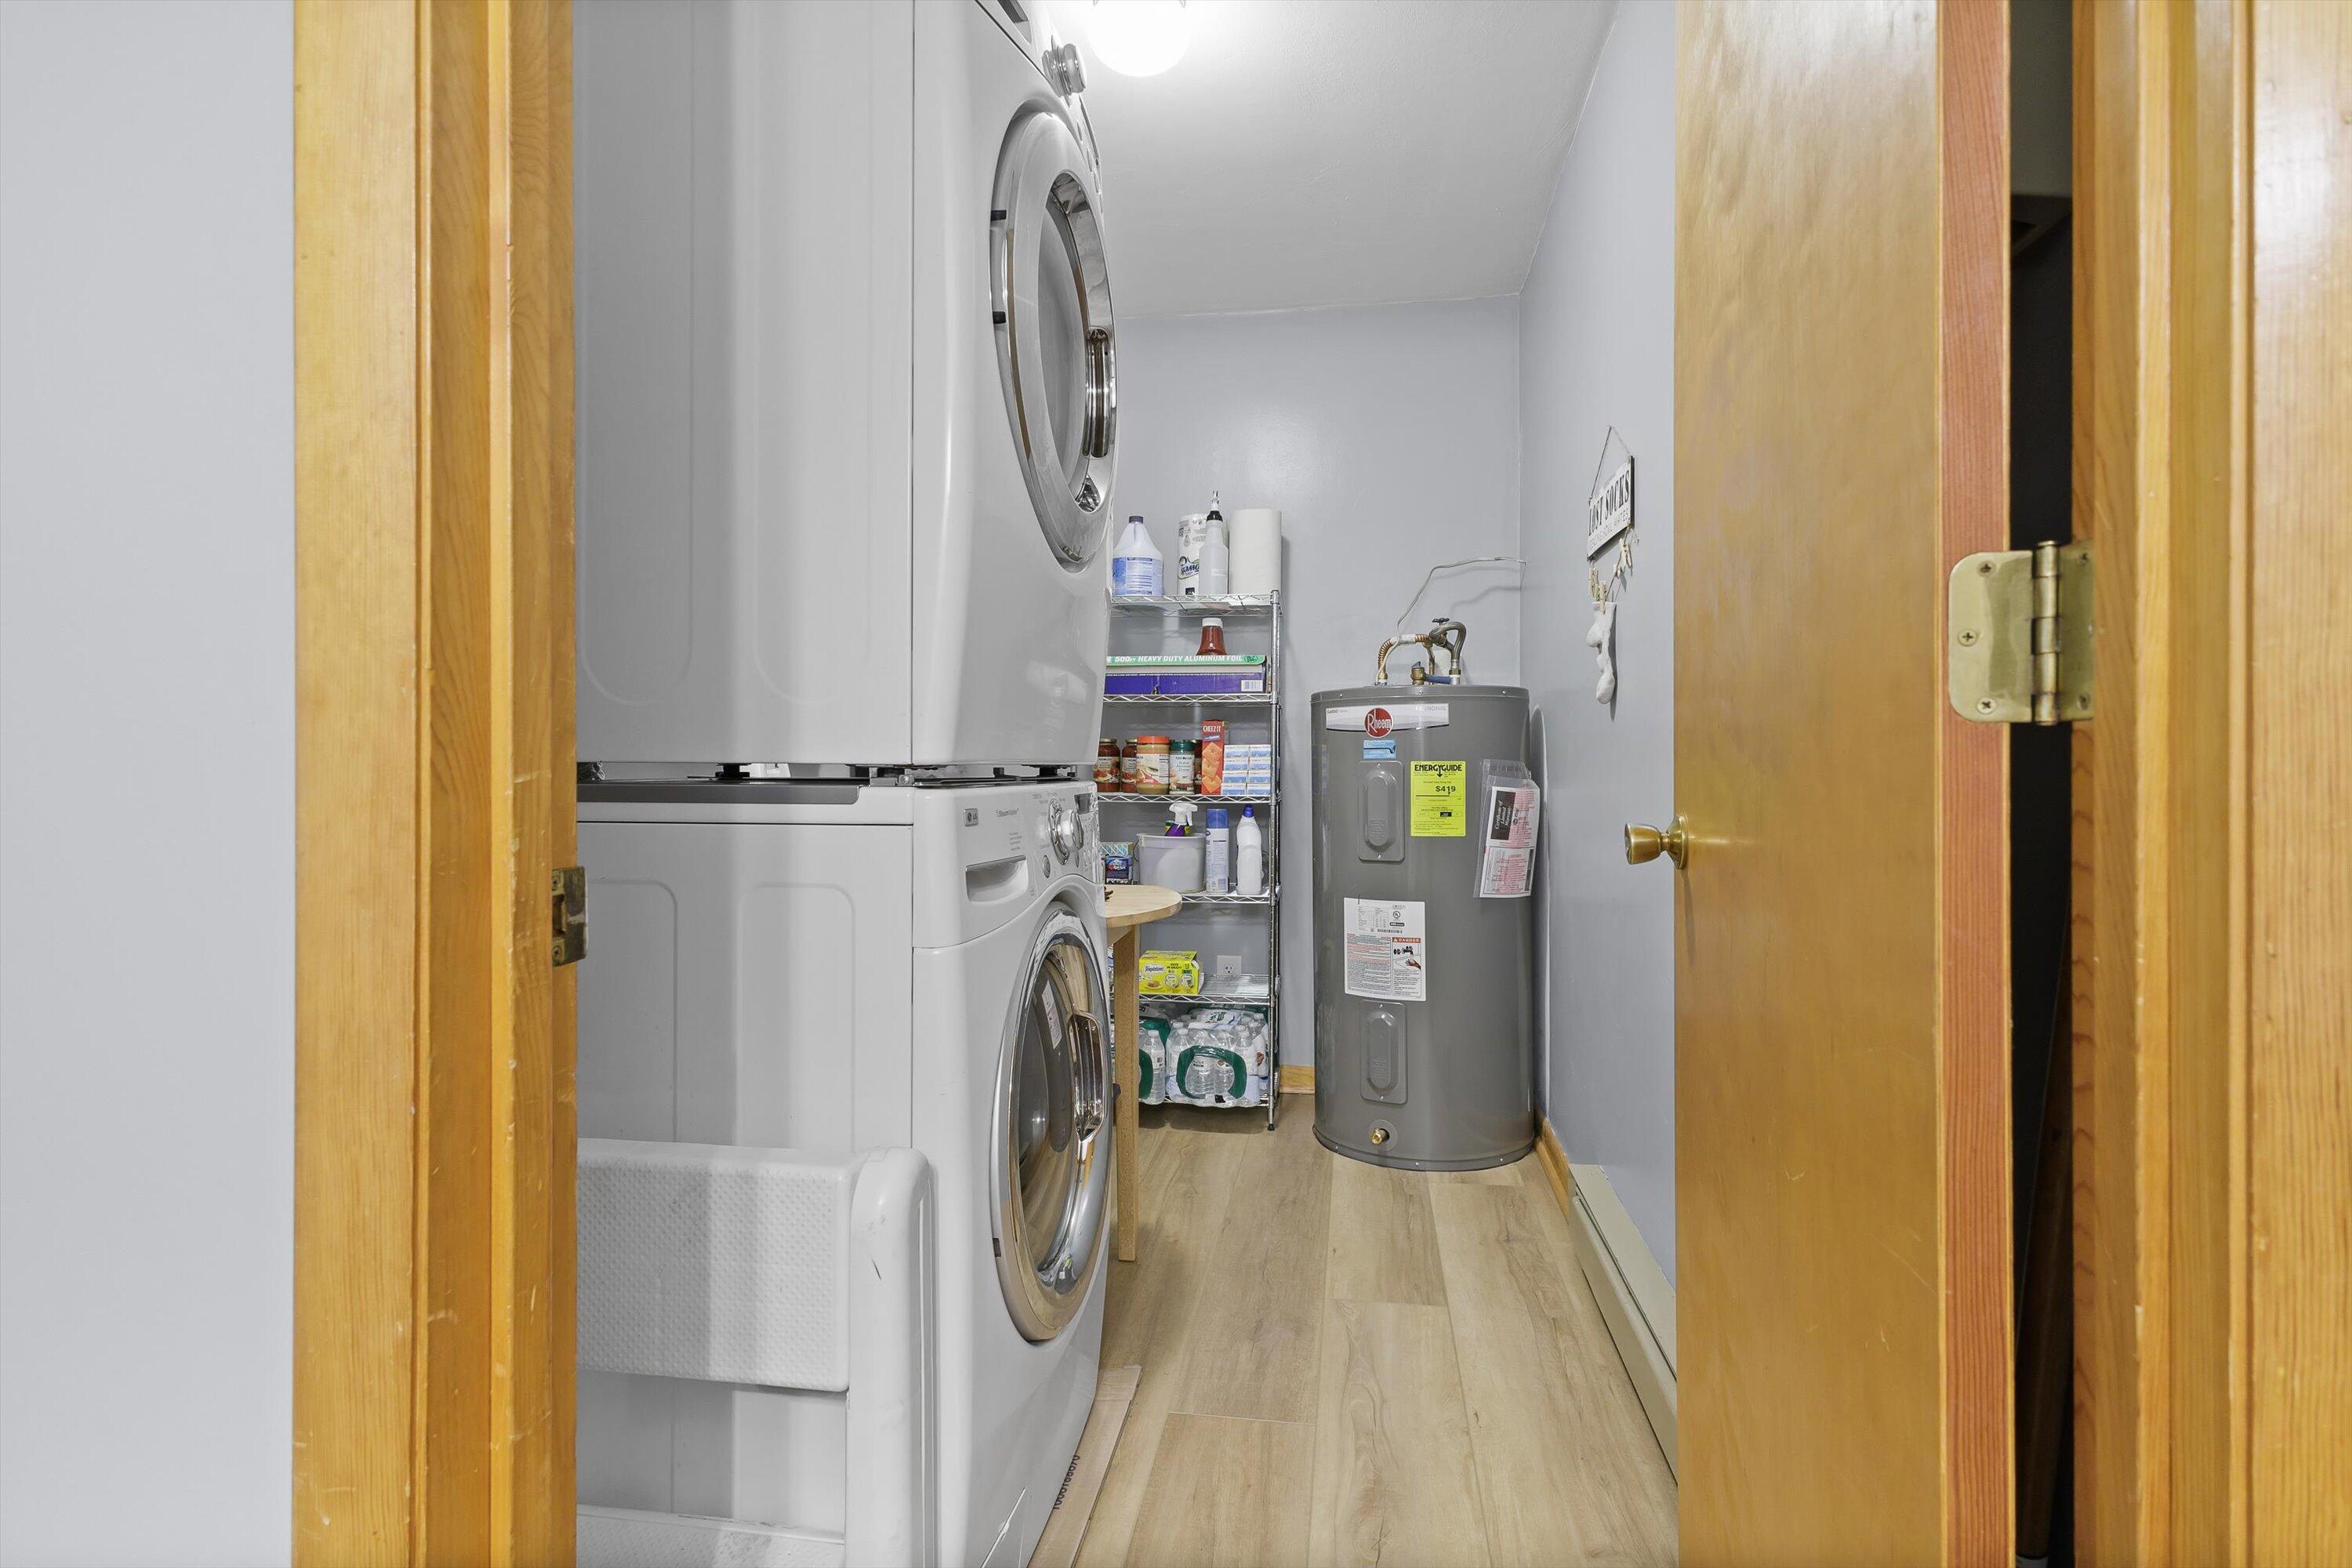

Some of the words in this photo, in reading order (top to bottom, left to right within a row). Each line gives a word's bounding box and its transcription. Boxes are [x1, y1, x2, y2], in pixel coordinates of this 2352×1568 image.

[1606, 470, 1629, 520] SOCKS
[1367, 708, 1392, 733] Rheem
[1414, 764, 1463, 772] ENERGYGUIDE
